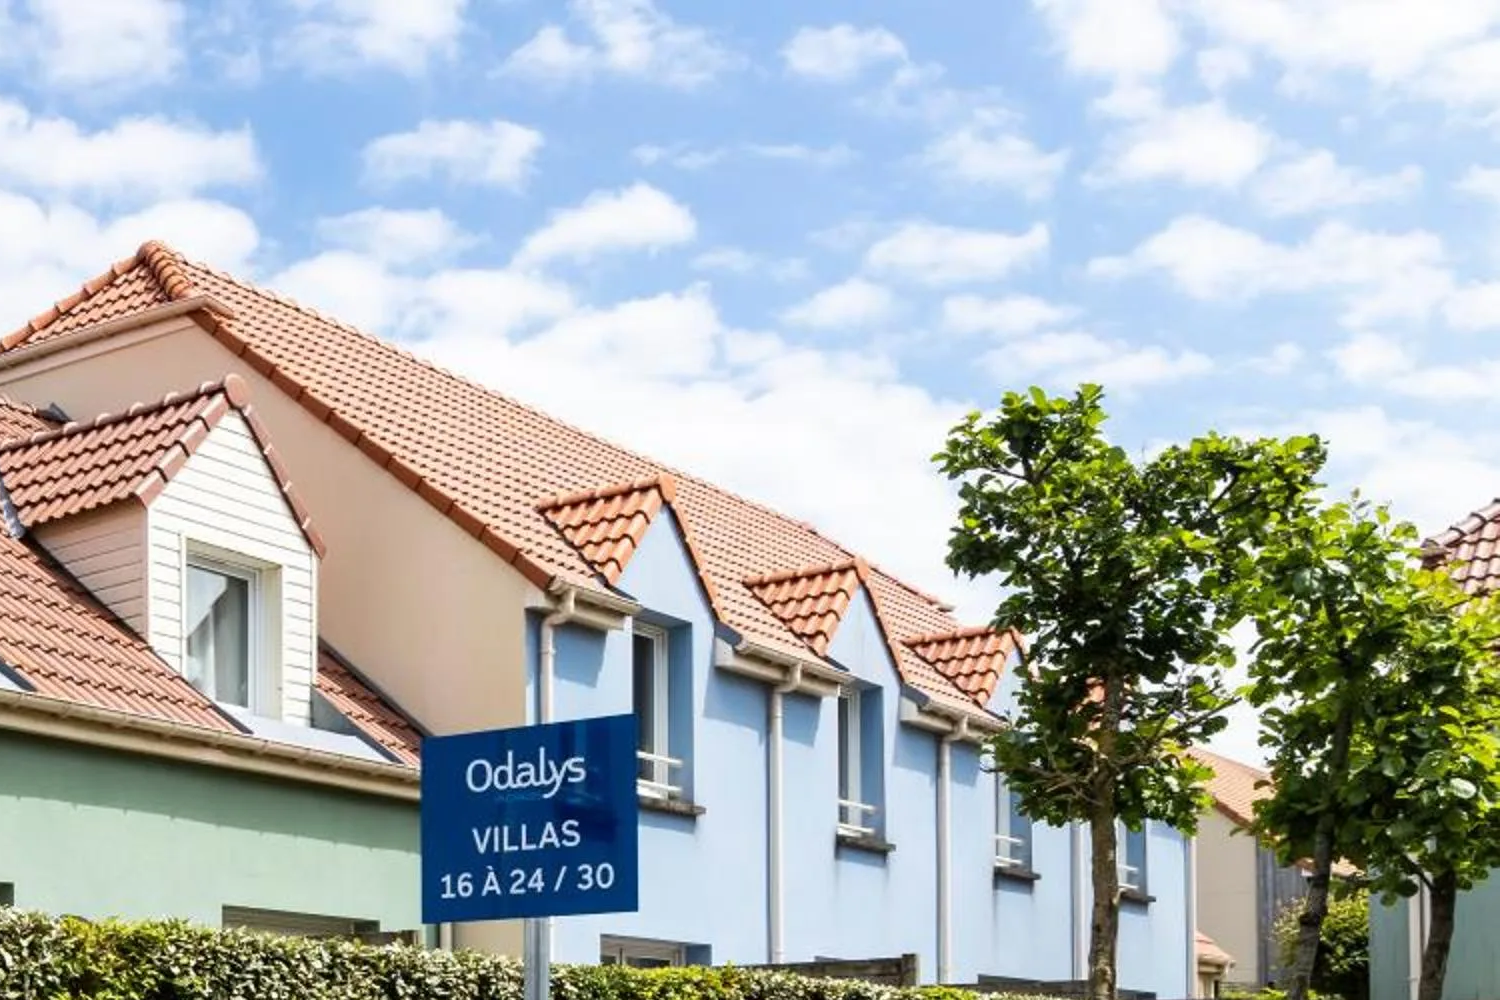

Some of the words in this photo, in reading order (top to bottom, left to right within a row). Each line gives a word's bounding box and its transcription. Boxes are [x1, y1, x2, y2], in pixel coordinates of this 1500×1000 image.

[466, 747, 586, 799] Odalys
[472, 819, 581, 854] VILLAS
[440, 873, 473, 899] 16
[481, 865, 501, 897] À
[510, 868, 545, 894] 24
[554, 866, 567, 892] /
[577, 863, 615, 890] 30
